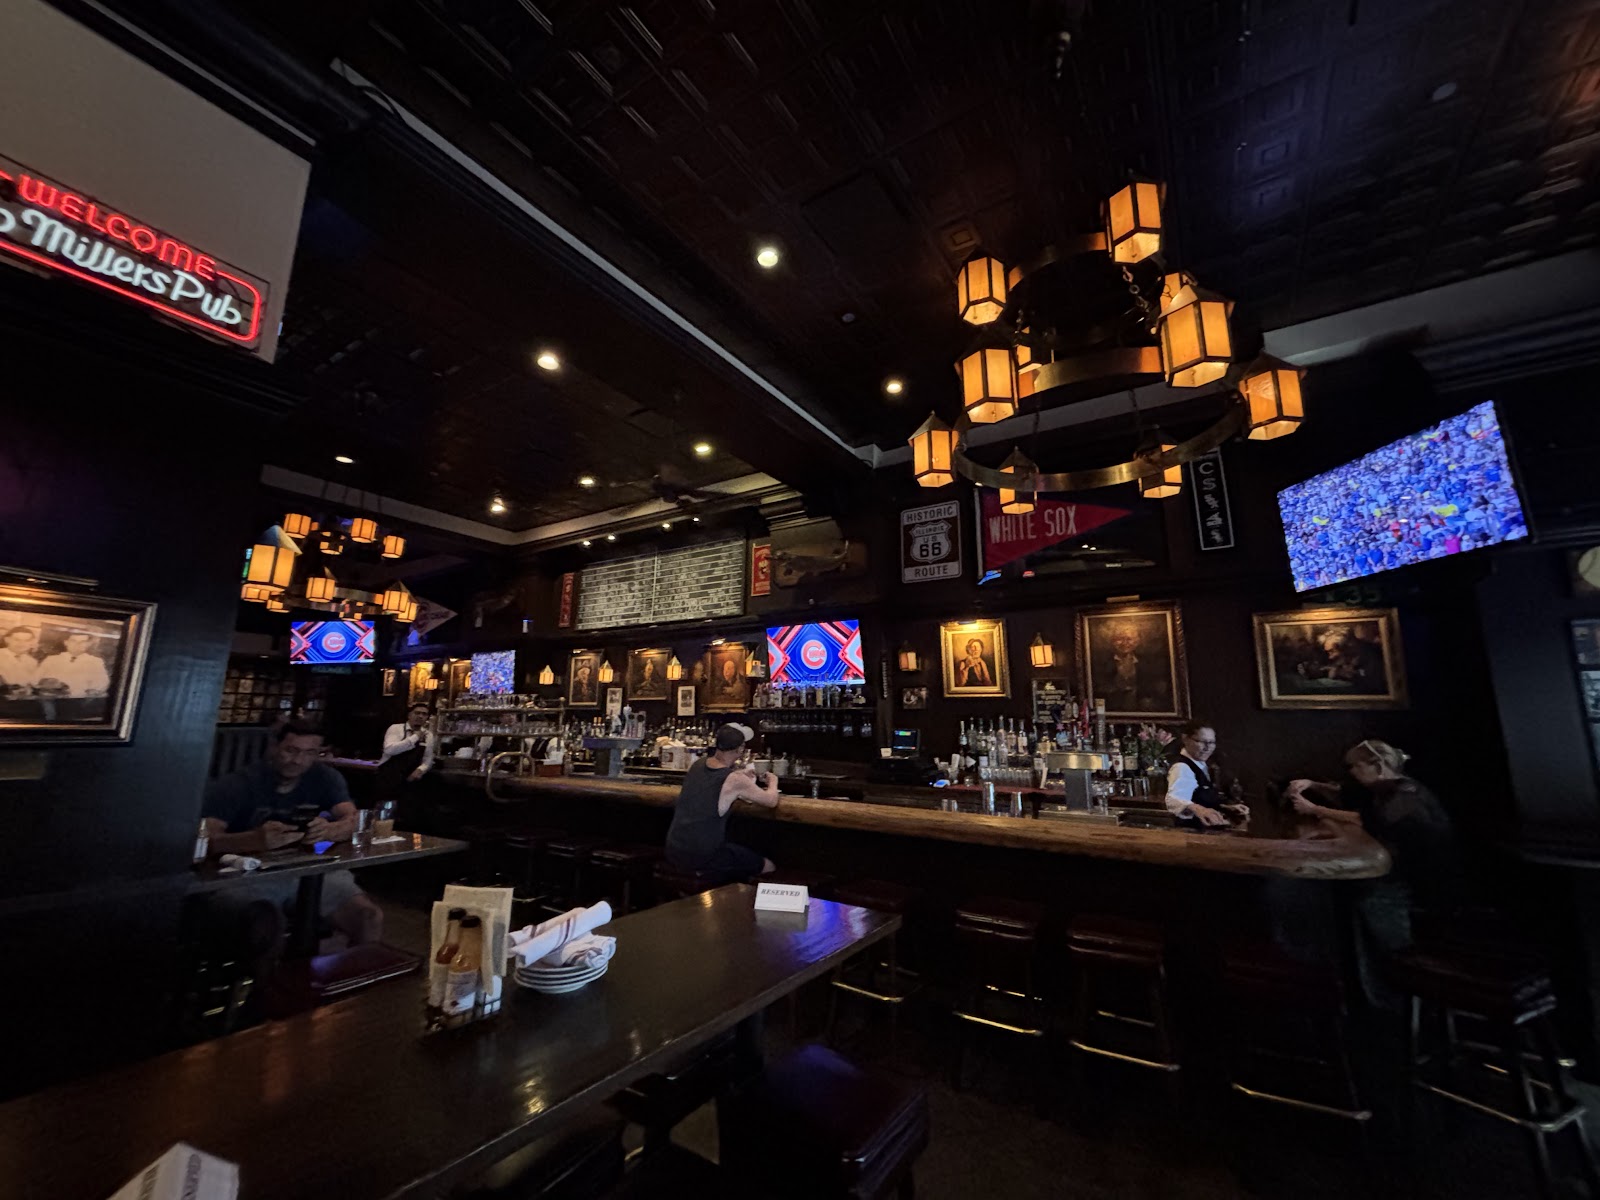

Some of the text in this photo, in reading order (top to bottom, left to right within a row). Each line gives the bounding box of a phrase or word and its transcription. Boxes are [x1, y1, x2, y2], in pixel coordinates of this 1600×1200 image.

[18, 173, 217, 281] WELCOME
[169, 269, 242, 325] Pub
[906, 505, 954, 523] HISTORIC
[988, 504, 1078, 545] WHITE SOX
[919, 541, 942, 558] 66
[914, 564, 949, 578] ROUTE
[760, 888, 801, 897] RESERVED
